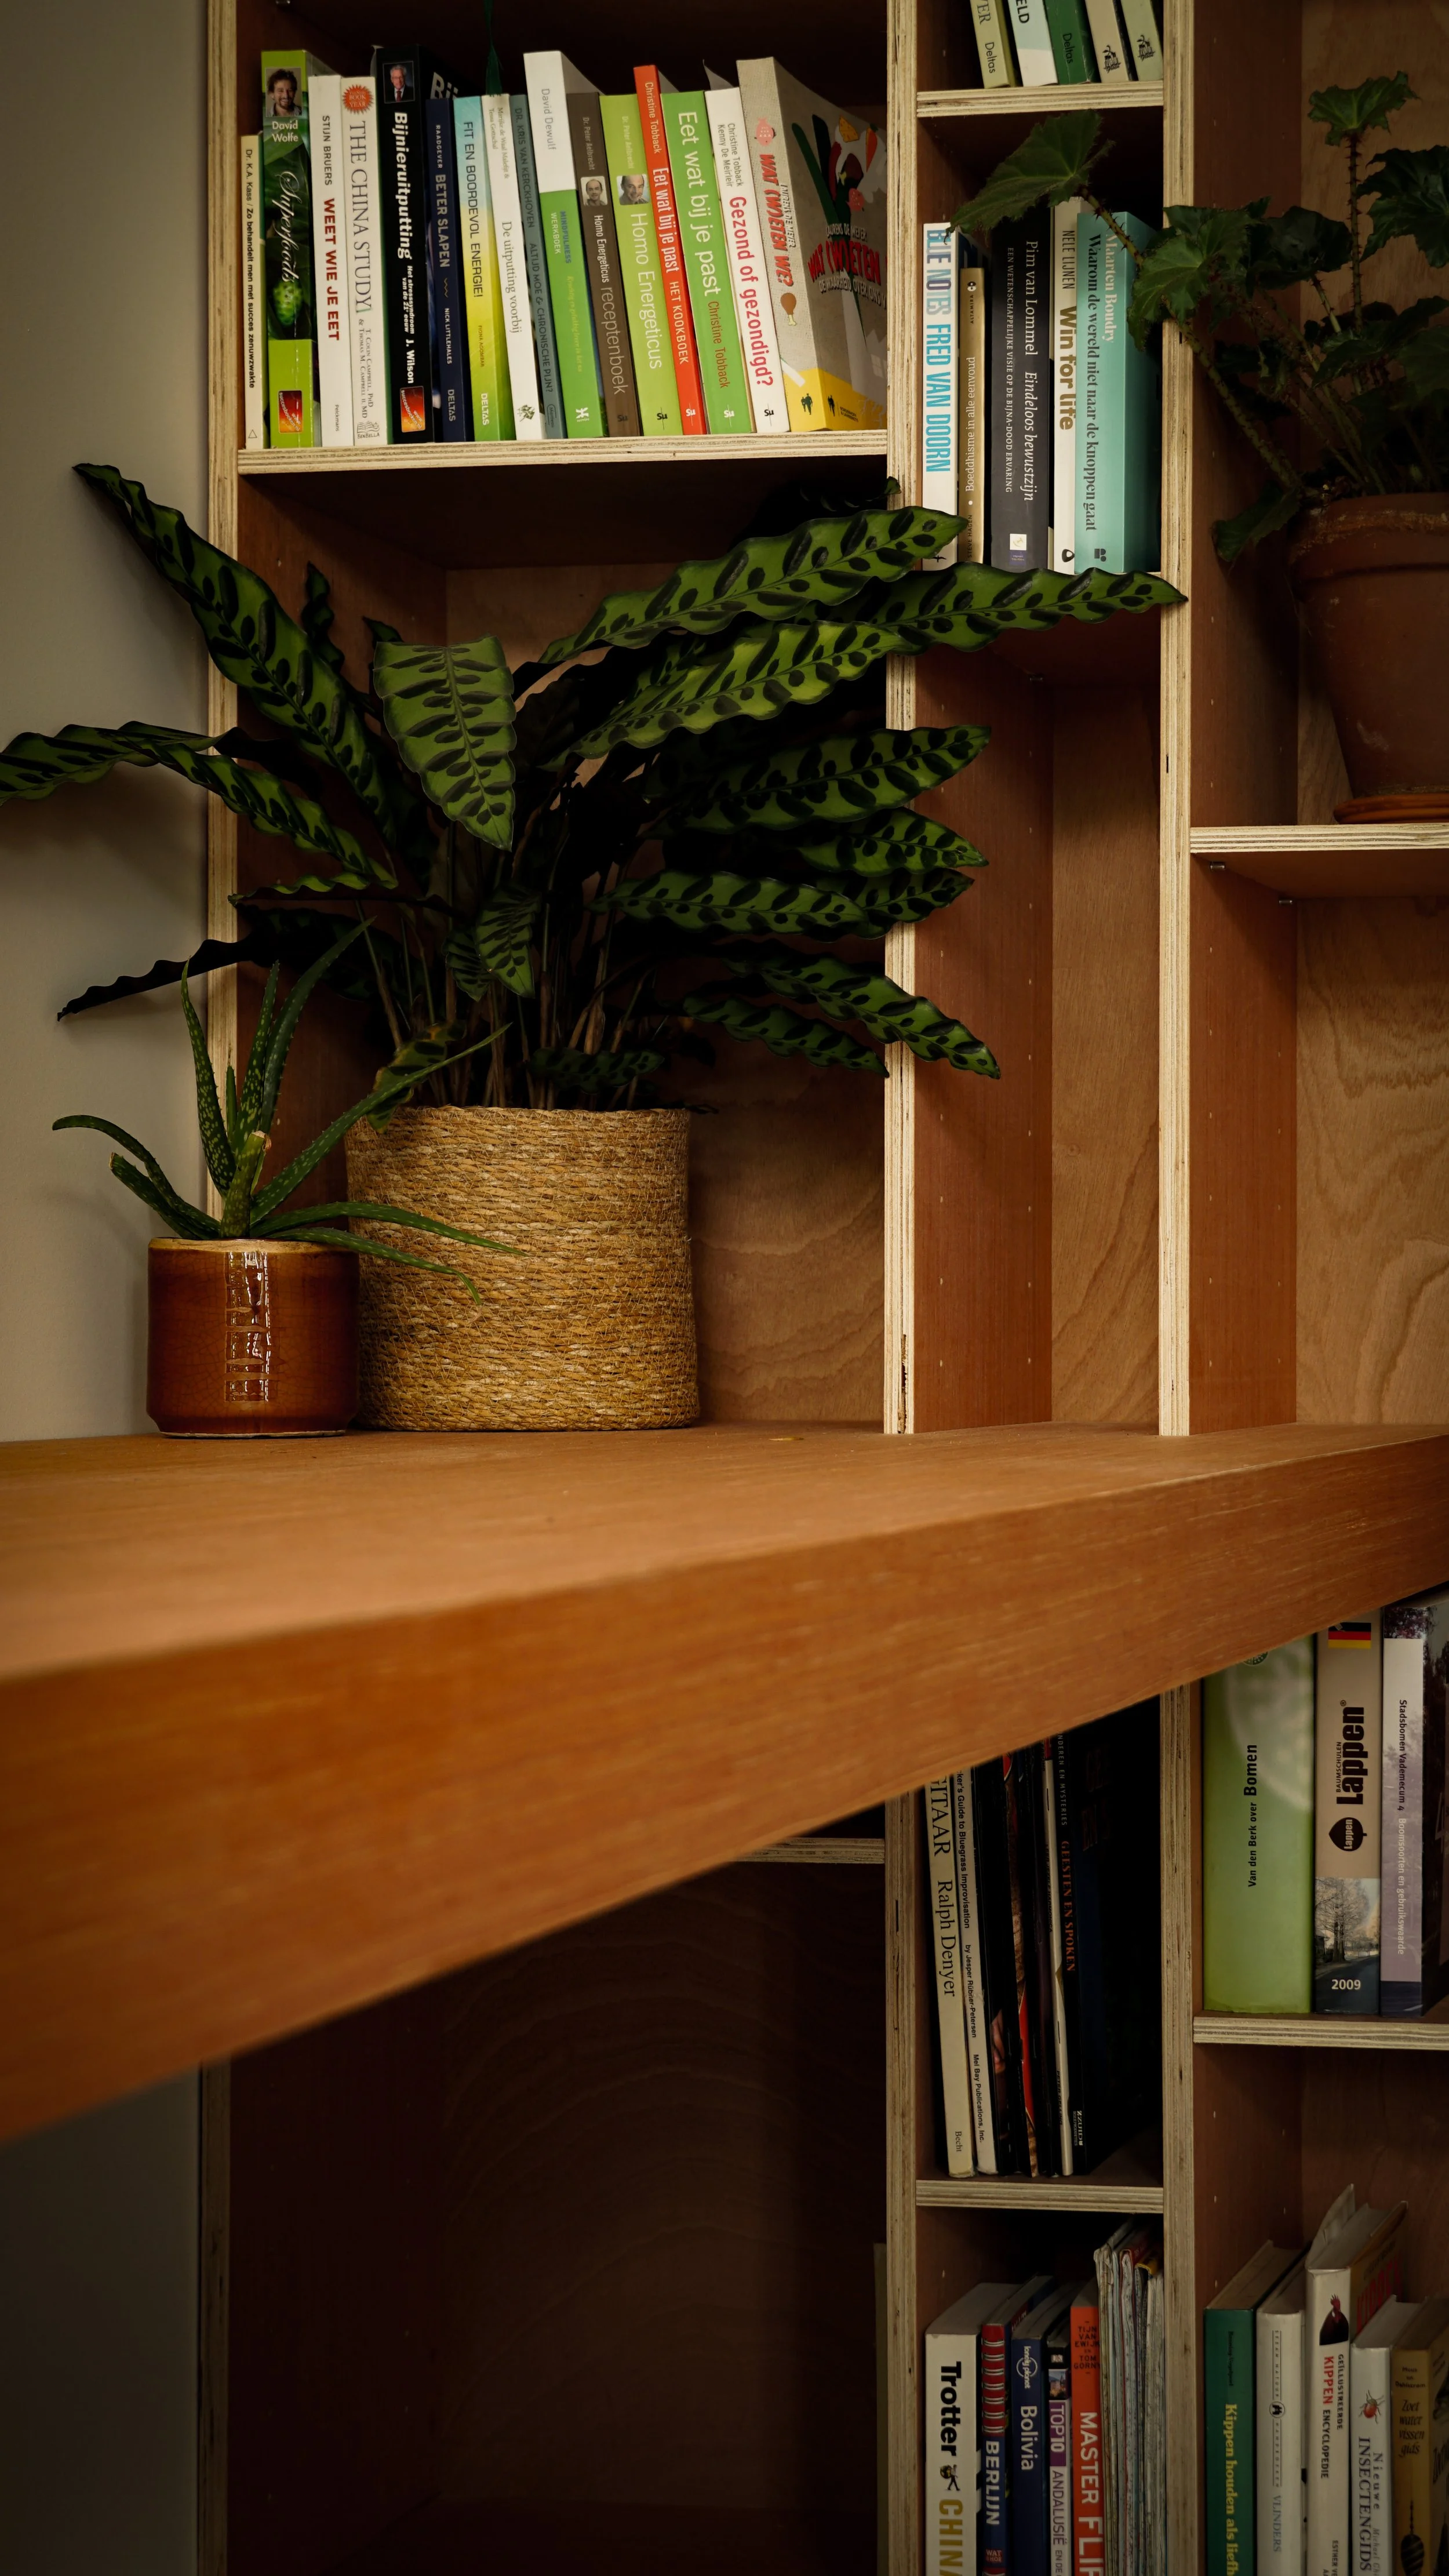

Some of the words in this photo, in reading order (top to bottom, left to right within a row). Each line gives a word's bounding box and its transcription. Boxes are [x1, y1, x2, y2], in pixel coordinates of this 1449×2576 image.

[985, 42, 996, 74] Deltas
[1062, 33, 1073, 64] Deltas
[541, 88, 552, 115] David
[645, 82, 655, 119] Christine
[272, 120, 298, 130] David
[272, 133, 298, 143] Wolfe
[322, 115, 331, 142] STIJN
[349, 121, 367, 163] THE
[464, 121, 474, 139] FIT
[517, 126, 525, 145] KRIS
[543, 117, 556, 151] Dewulf
[650, 119, 660, 154] Tobback
[678, 111, 698, 145] Eet
[727, 123, 738, 157] Christine
[323, 146, 332, 185] BRUERS
[465, 144, 476, 161] EN
[519, 146, 527, 164] VAN
[685, 151, 706, 189] wat
[392, 111, 413, 260] Bijnieruitputting
[653, 167, 669, 188] Eet
[732, 157, 742, 187] Tobback
[351, 169, 370, 237] CHINA
[435, 174, 447, 215] BETER
[466, 165, 480, 239] BOORDEVOL
[522, 166, 534, 228] KERCKHOVEN
[656, 190, 673, 213] wat
[688, 194, 711, 222] bij
[272, 170, 303, 283] Superfoods
[324, 198, 337, 245] WEET
[502, 221, 513, 238] De
[551, 212, 561, 254] WERKBOEK
[593, 214, 603, 237] Homo
[629, 213, 650, 264] Homo
[658, 213, 677, 233] bij
[660, 231, 677, 245] je
[690, 223, 711, 244] je
[730, 197, 755, 260] Gezond
[438, 218, 450, 267] SLAPEN
[530, 243, 540, 272] ALTIJD
[596, 238, 610, 283] Energeticus
[662, 246, 680, 274] past
[1026, 240, 1038, 268] Pim
[1062, 230, 1075, 253] NELE
[326, 249, 338, 281] WIE
[354, 241, 372, 314] STUDY
[471, 243, 484, 297] ENERGIE!
[503, 239, 516, 294] uitputting
[694, 250, 722, 297] past
[740, 265, 759, 285] of
[1062, 257, 1075, 289] LIJNEN
[1087, 234, 1101, 292] Waarom
[1104, 234, 1117, 292] Maarten
[327, 285, 338, 305] JE
[534, 274, 543, 294] MOE
[536, 296, 544, 305] &
[669, 281, 680, 302] HET
[1025, 271, 1035, 296] van
[1087, 294, 1100, 311] de
[328, 311, 340, 340] EET
[508, 295, 522, 333] voorbij
[637, 270, 663, 369] Energeticus
[708, 301, 722, 344] Christine
[1004, 264, 1014, 350] WETENSCHAPPELIJKE
[1101, 293, 1117, 343] Boudry
[406, 338, 414, 350] J.
[537, 305, 550, 368] CHRONISCHE
[600, 287, 629, 395] receptenboek
[672, 304, 689, 365] KOOKBOEK
[739, 288, 773, 387] gezondigd?
[926, 324, 951, 365] FRED
[1025, 299, 1039, 356] Lommel
[1060, 306, 1077, 350] Win
[1087, 313, 1100, 359] wereld
[407, 350, 416, 384] Wilson
[544, 369, 552, 392] PIJN?
[714, 346, 729, 388] Tobback
[1006, 374, 1013, 386] OP
[1060, 355, 1077, 389] for
[1087, 359, 1100, 387] niet
[926, 372, 951, 407] VAN
[1006, 387, 1013, 398] DE
[1024, 371, 1039, 431] Eindeloos
[1086, 388, 1097, 420] naar
[480, 392, 490, 426] DELTAS
[1005, 399, 1013, 452] BIJNA-DOOD
[1059, 393, 1077, 430] life
[926, 414, 951, 472] DOORN
[1086, 422, 1099, 439] de
[1005, 452, 1013, 493] ERVARING
[1020, 434, 1039, 501] bewustzijn
[1083, 442, 1099, 500] knoppen
[1083, 502, 1097, 532] gaat
[1399, 1699, 1407, 1752] Stadsbomen
[1243, 1744, 1257, 1796] Bomen
[1336, 1706, 1368, 1805] Lappen
[1398, 1753, 1407, 1803] Vademecum
[1248, 1825, 1257, 1847] Berk
[1344, 1818, 1354, 1851] Lappen
[1397, 1817, 1407, 1872] Boomsoorten
[1061, 1840, 1072, 1897] GEESTEN
[1248, 1850, 1257, 1867] den
[1248, 1871, 1257, 1888] Van
[1397, 1875, 1404, 1886] en
[935, 1880, 955, 1930] Ralph
[1063, 1899, 1074, 1918] EN
[1396, 1887, 1407, 1955] gebruikswaarde
[1064, 1920, 1076, 1973] SPOKEN
[938, 1935, 957, 1998] Denyer
[1331, 1978, 1361, 1991] 2009
[975, 2083, 984, 2129] Publications,
[1323, 2355, 1334, 2405] KIPPEN
[1337, 2353, 1345, 2431] GEÏLLUSTREERDE
[940, 2361, 962, 2457] Trotter
[1400, 2415, 1423, 2426] water
[1401, 2399, 1421, 2411] Zoet
[1020, 2404, 1039, 2471] Bolivia
[1223, 2403, 1237, 2458] Kippen
[1320, 2409, 1331, 2479] ENCYCLOPEDIE
[1399, 2429, 1425, 2440] vissen
[1079, 2411, 1100, 2504] MASTER
[1399, 2442, 1420, 2458] gids
[985, 2440, 1000, 2526] BERLIJN
[1225, 2459, 1238, 2515] houden
[1373, 2453, 1384, 2510] Nieuwe
[1053, 2470, 1064, 2546] ANDALUSIË
[1358, 2436, 1372, 2571] INSECTENGIDS
[939, 2498, 963, 2576] CHIN
[1226, 2517, 1238, 2541] als
[1272, 2495, 1282, 2553] VLINDERS
[1055, 2549, 1062, 2559] EN
[1055, 2560, 1062, 2570] DE
